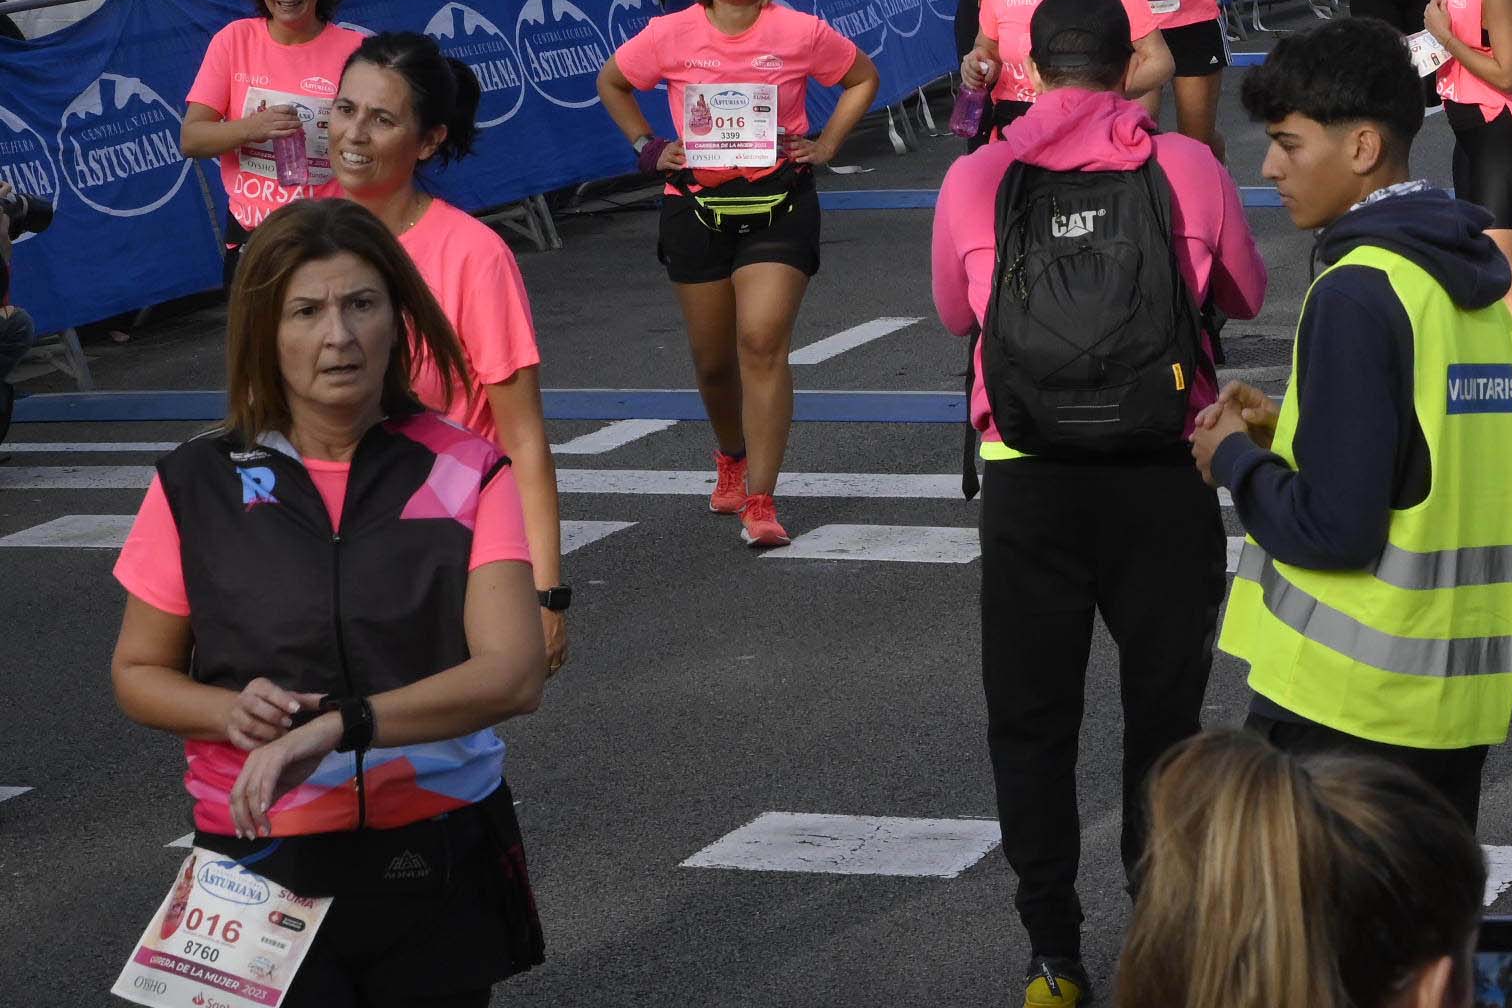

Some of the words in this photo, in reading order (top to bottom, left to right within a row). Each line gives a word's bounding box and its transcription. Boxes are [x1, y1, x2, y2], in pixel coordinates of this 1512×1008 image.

[532, 29, 560, 45] CENTRAL
[563, 27, 594, 41] LECHERA
[523, 36, 606, 84] ASTURIANA
[684, 60, 721, 69] OYSHO
[475, 56, 521, 93] RIANA
[82, 121, 122, 142] CENTRAL
[715, 116, 745, 129] 016
[720, 131, 740, 140] 3399
[70, 127, 183, 190] ASTURIANA
[247, 160, 275, 173] OYSHO
[692, 153, 721, 161] OYSHO
[233, 202, 271, 227] SUM
[1052, 210, 1094, 237] CAT
[201, 868, 263, 903] ASTURIANA
[278, 888, 315, 910] SUMA
[185, 907, 243, 944] 016
[183, 940, 221, 964] 8760
[175, 961, 192, 974] DE
[192, 964, 205, 978] LA
[204, 970, 240, 991] MUJER
[242, 983, 268, 999] 2023
